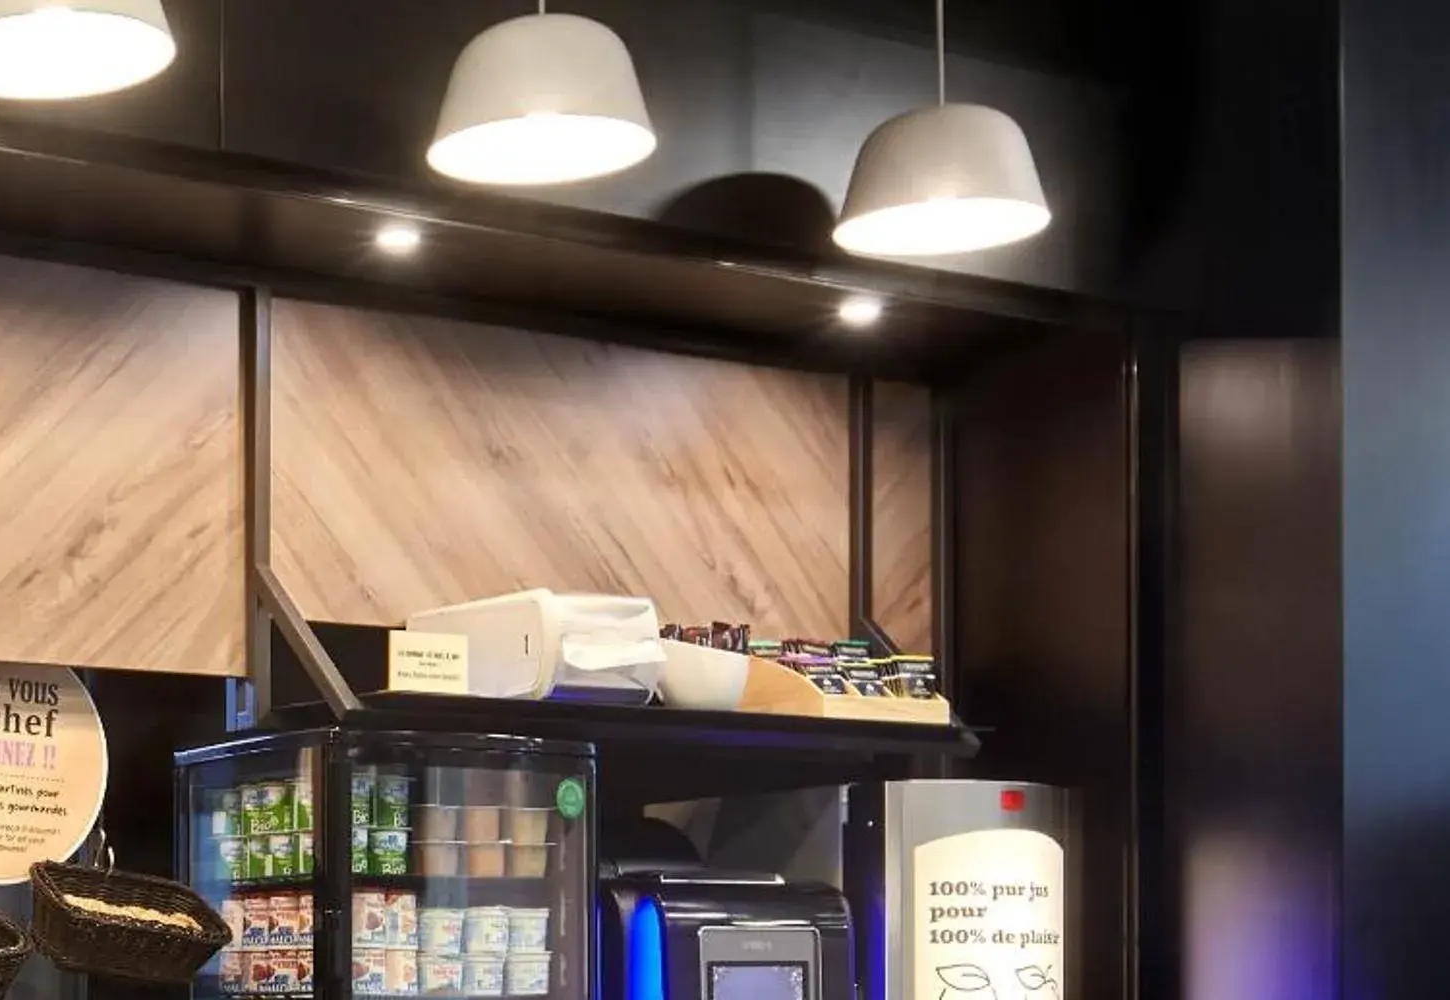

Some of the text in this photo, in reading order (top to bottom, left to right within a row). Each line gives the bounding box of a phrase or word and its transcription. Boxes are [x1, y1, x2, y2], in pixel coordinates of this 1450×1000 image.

[8, 678, 59, 706] vous
[929, 881, 1049, 902] 100% pur jus
[929, 906, 987, 923] pour
[929, 929, 987, 944] 100%
[991, 929, 1016, 944] de
